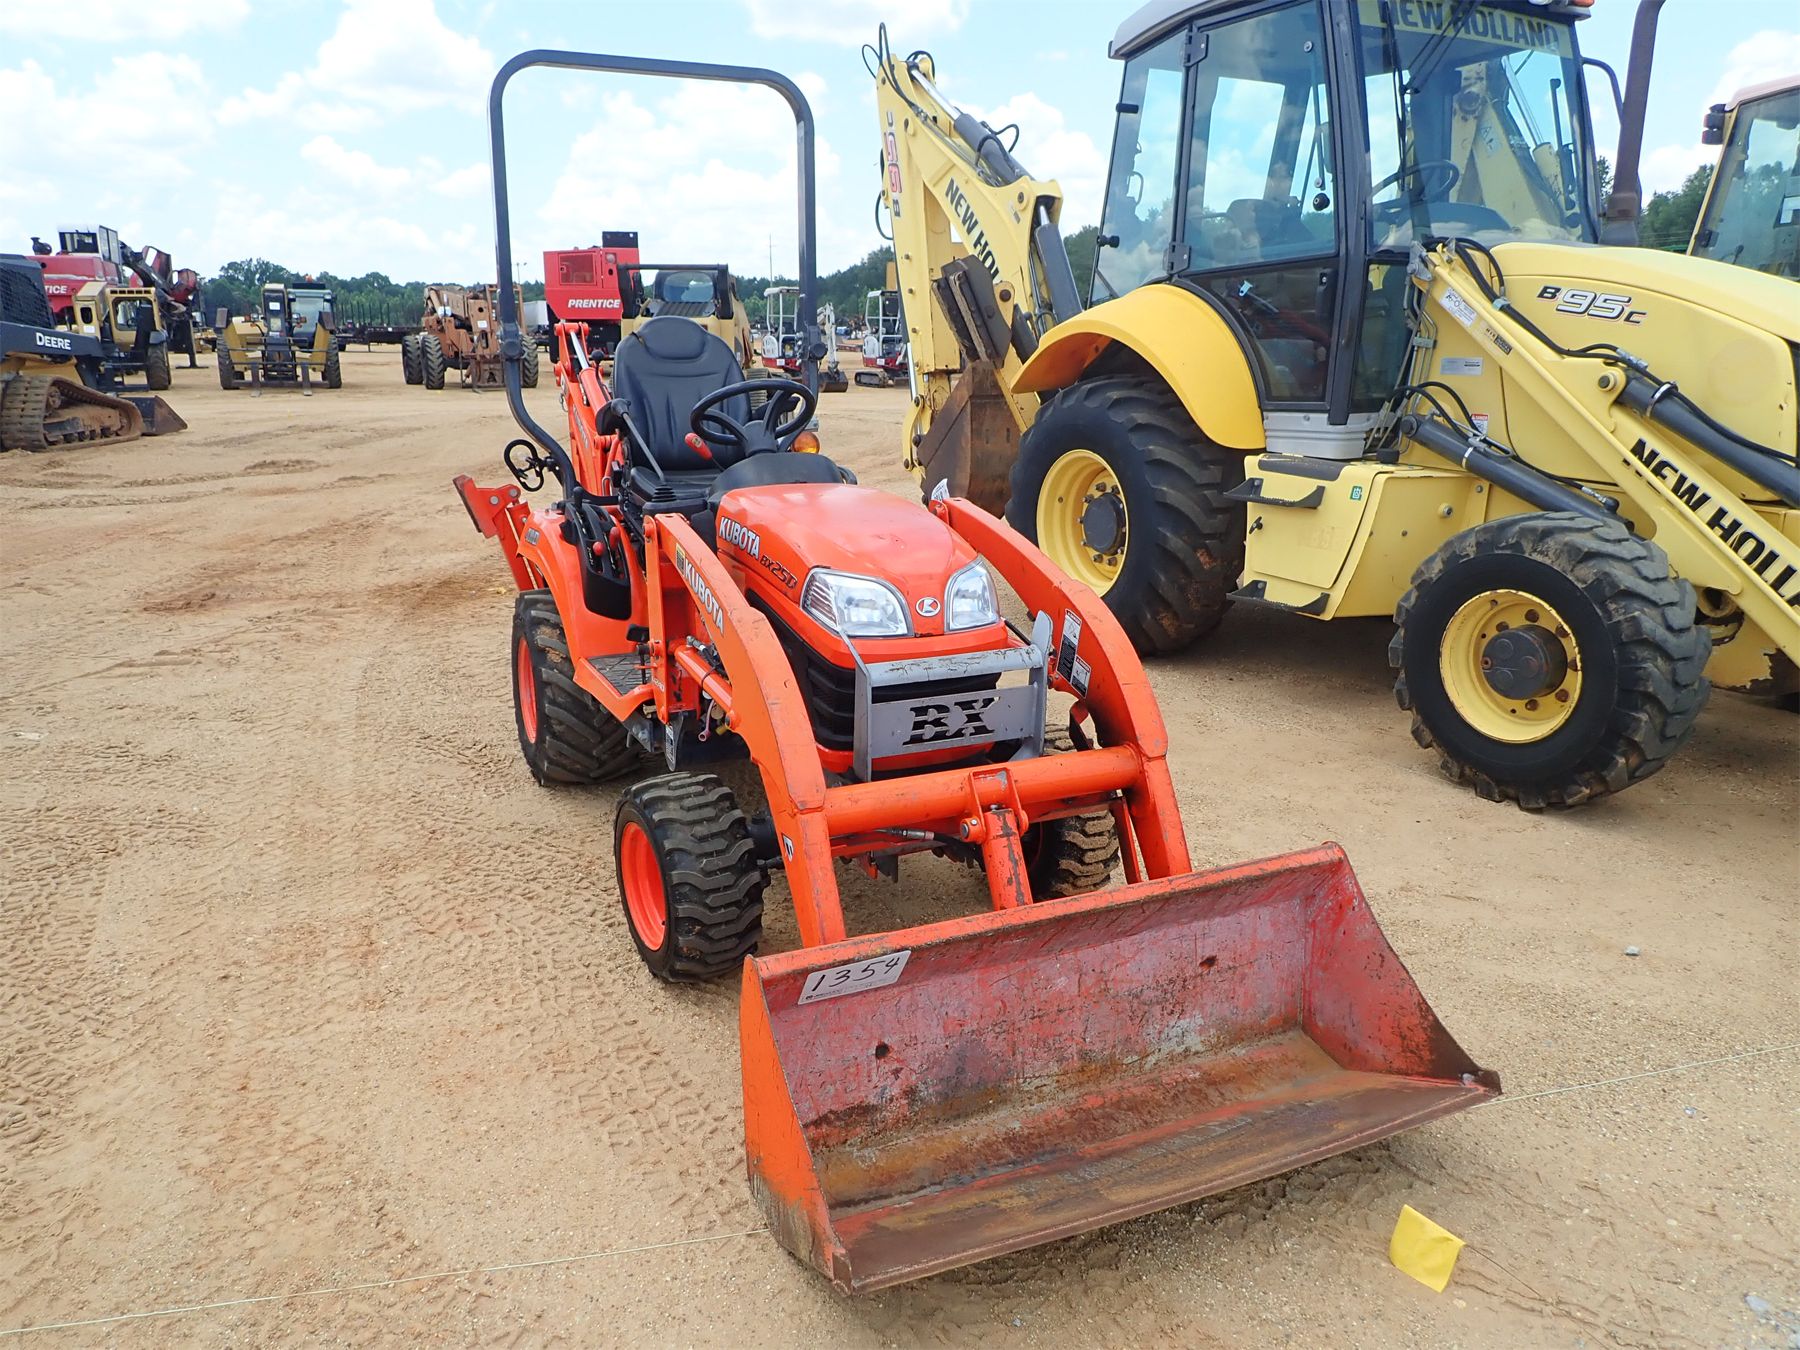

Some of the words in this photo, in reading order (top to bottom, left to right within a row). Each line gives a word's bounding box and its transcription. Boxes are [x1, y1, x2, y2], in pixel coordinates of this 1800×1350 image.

[945, 177, 979, 236] NEW
[568, 299, 621, 309] PRENTICE
[35, 331, 71, 350] DEERE
[1622, 437, 1712, 513] NEW
[719, 516, 760, 560] KUBOTA
[685, 558, 725, 636] KUBOTA
[811, 957, 901, 992] 1354
